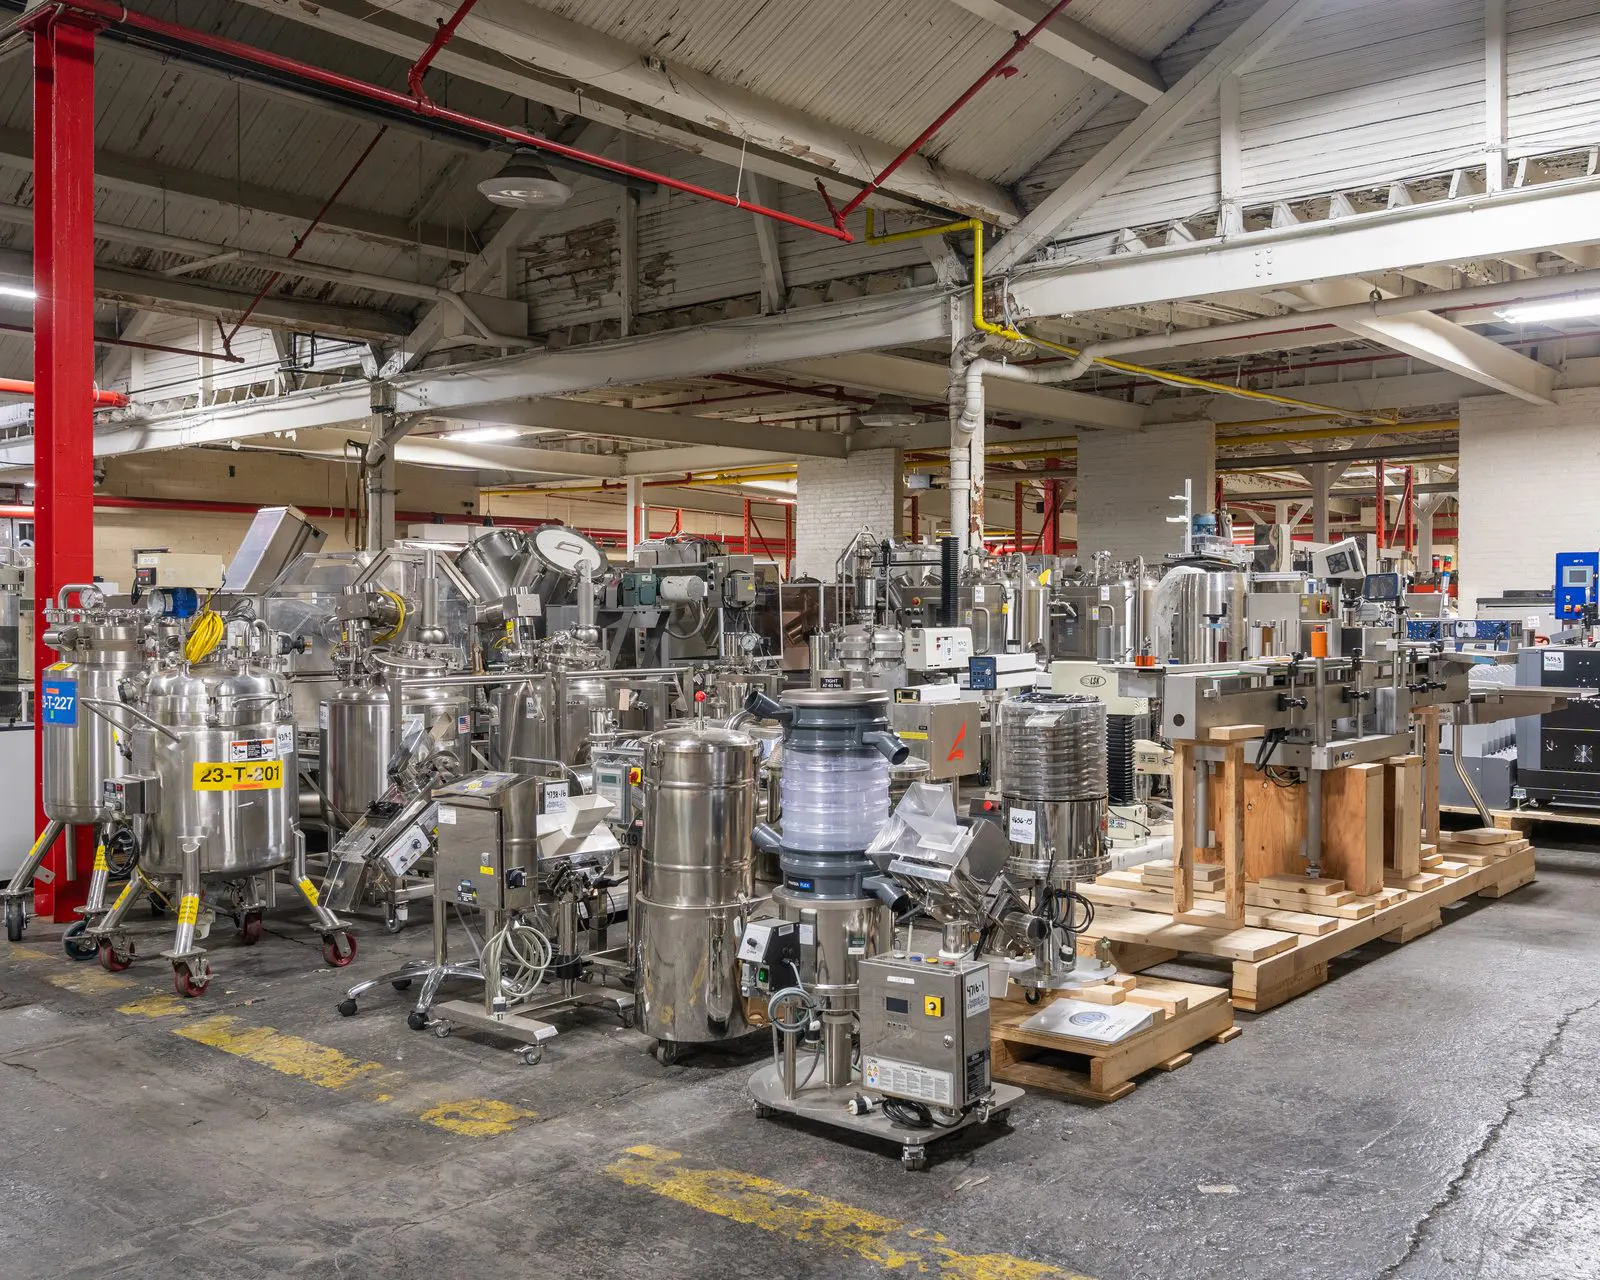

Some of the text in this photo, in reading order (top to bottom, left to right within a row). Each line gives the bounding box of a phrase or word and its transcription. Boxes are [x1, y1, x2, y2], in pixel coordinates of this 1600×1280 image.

[200, 765, 279, 783] 23-T-201
[616, 833, 638, 846] -019
[966, 980, 985, 998] 4716-1
